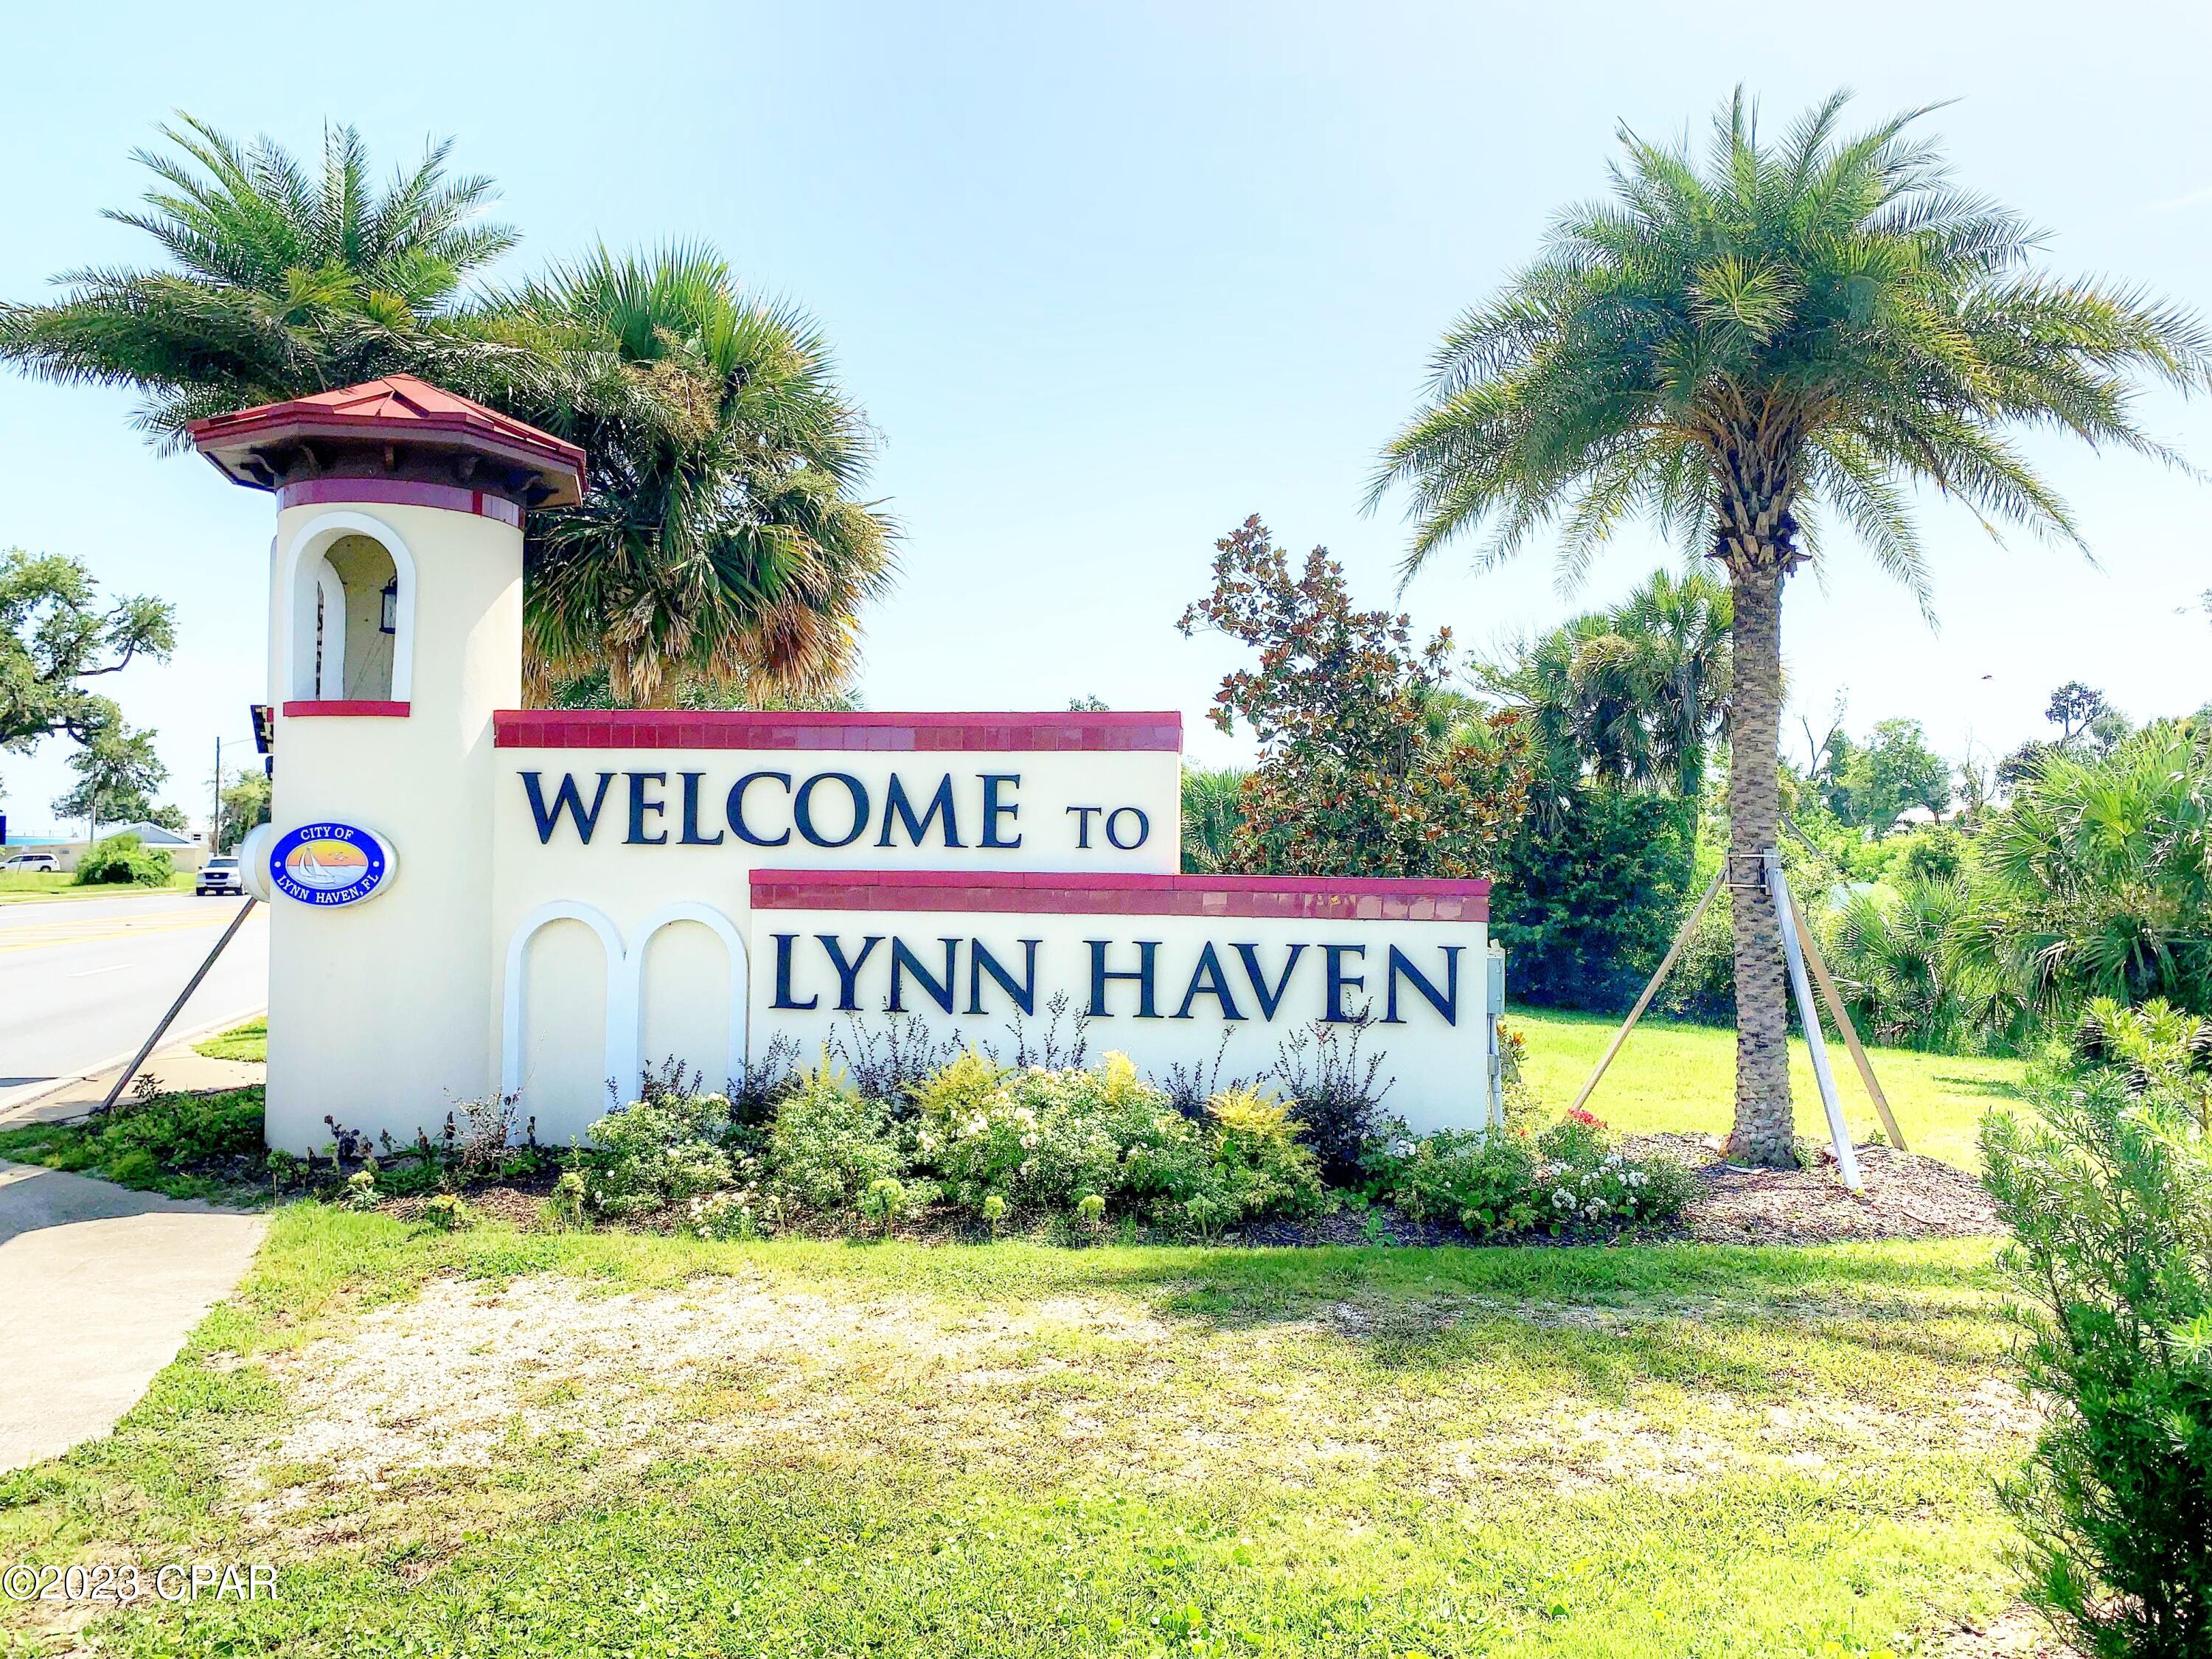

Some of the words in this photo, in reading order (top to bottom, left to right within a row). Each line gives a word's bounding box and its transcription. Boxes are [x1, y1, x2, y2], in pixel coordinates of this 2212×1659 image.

[300, 826, 332, 841] CITY
[334, 827, 354, 841] OF
[517, 771, 1023, 849] WELCOME
[1065, 806, 1150, 850] TO
[276, 874, 310, 901] LYNN
[316, 886, 364, 904] HAVEN,
[361, 874, 380, 891] FL
[768, 933, 1043, 1018] LYNN
[1082, 939, 1466, 1027] HAVEN
